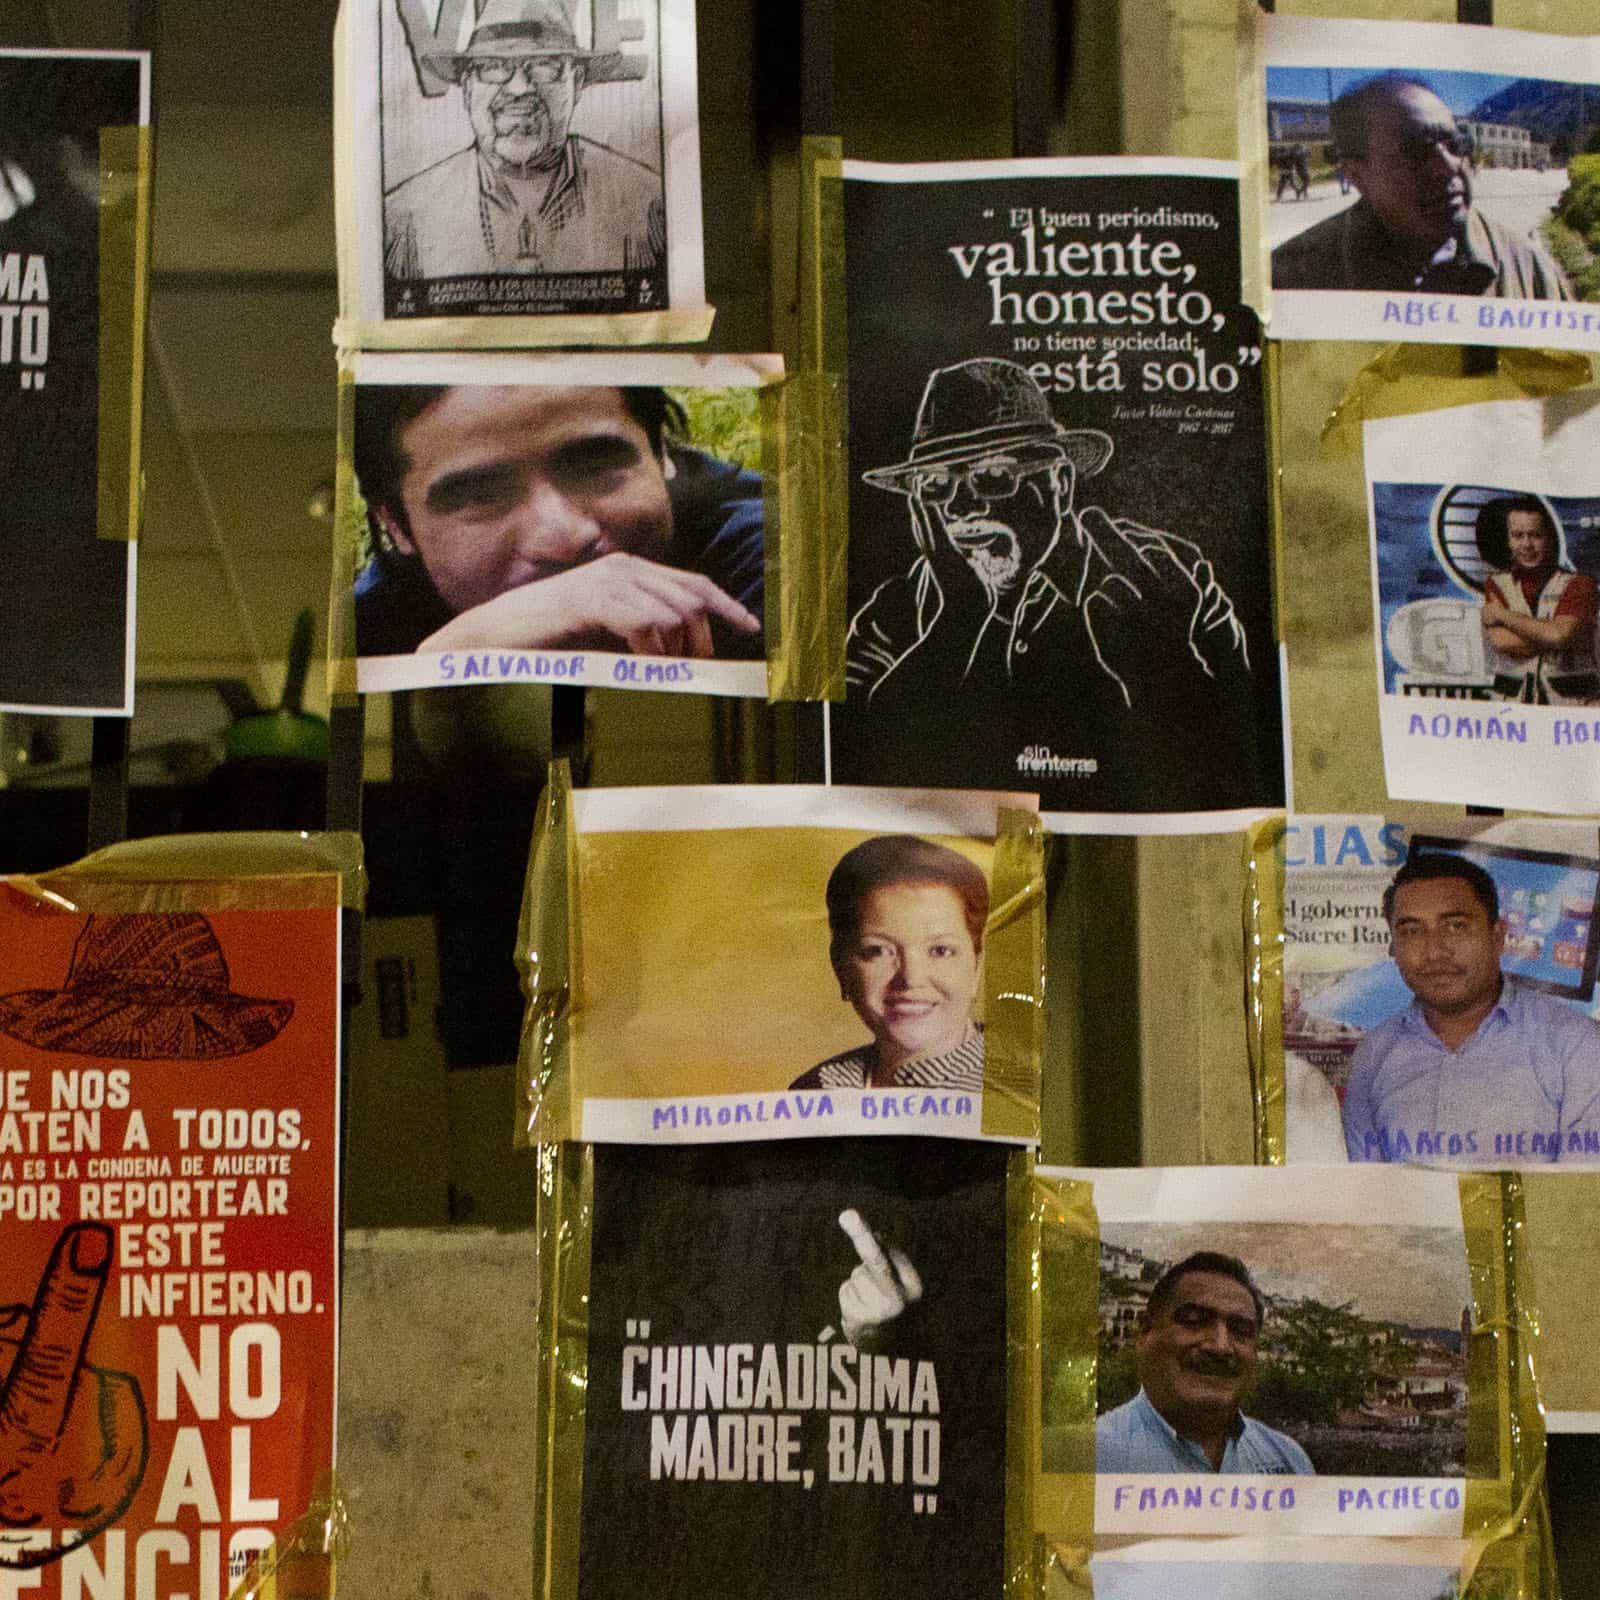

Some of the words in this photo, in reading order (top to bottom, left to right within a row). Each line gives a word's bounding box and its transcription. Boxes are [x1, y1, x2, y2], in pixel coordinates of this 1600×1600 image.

[1010, 207, 1034, 229] El
[1040, 207, 1091, 228] buen
[1098, 208, 1220, 231] periodismo,
[948, 224, 1197, 283] valiente,
[989, 279, 1226, 332] honesto,
[1382, 300, 1459, 325] ABEL
[1014, 336, 1042, 353] no
[1046, 333, 1097, 353] tiene
[1025, 351, 1126, 393] está
[441, 656, 584, 681] SALVADOR
[614, 659, 694, 684] OLMOS
[52, 1069, 132, 1111] NOS
[860, 1094, 973, 1120] BREACH
[121, 1110, 151, 1152] A
[172, 1108, 311, 1153] TODOS,
[22, 1158, 47, 1180] ES
[54, 1158, 79, 1179] LA
[87, 1155, 172, 1178] CONDENA
[180, 1154, 204, 1177] DE
[212, 1153, 292, 1176] MUERTE
[79, 1178, 289, 1221] REPORTEAR
[119, 1222, 226, 1268] ESTE
[119, 1270, 325, 1318] INFIERNO.
[156, 1322, 282, 1421] NO
[649, 1414, 815, 1489] MADRE,
[154, 1425, 279, 1523] AL
[1113, 1484, 1296, 1512] FRANCISCO
[1337, 1486, 1462, 1513] PACHECO
